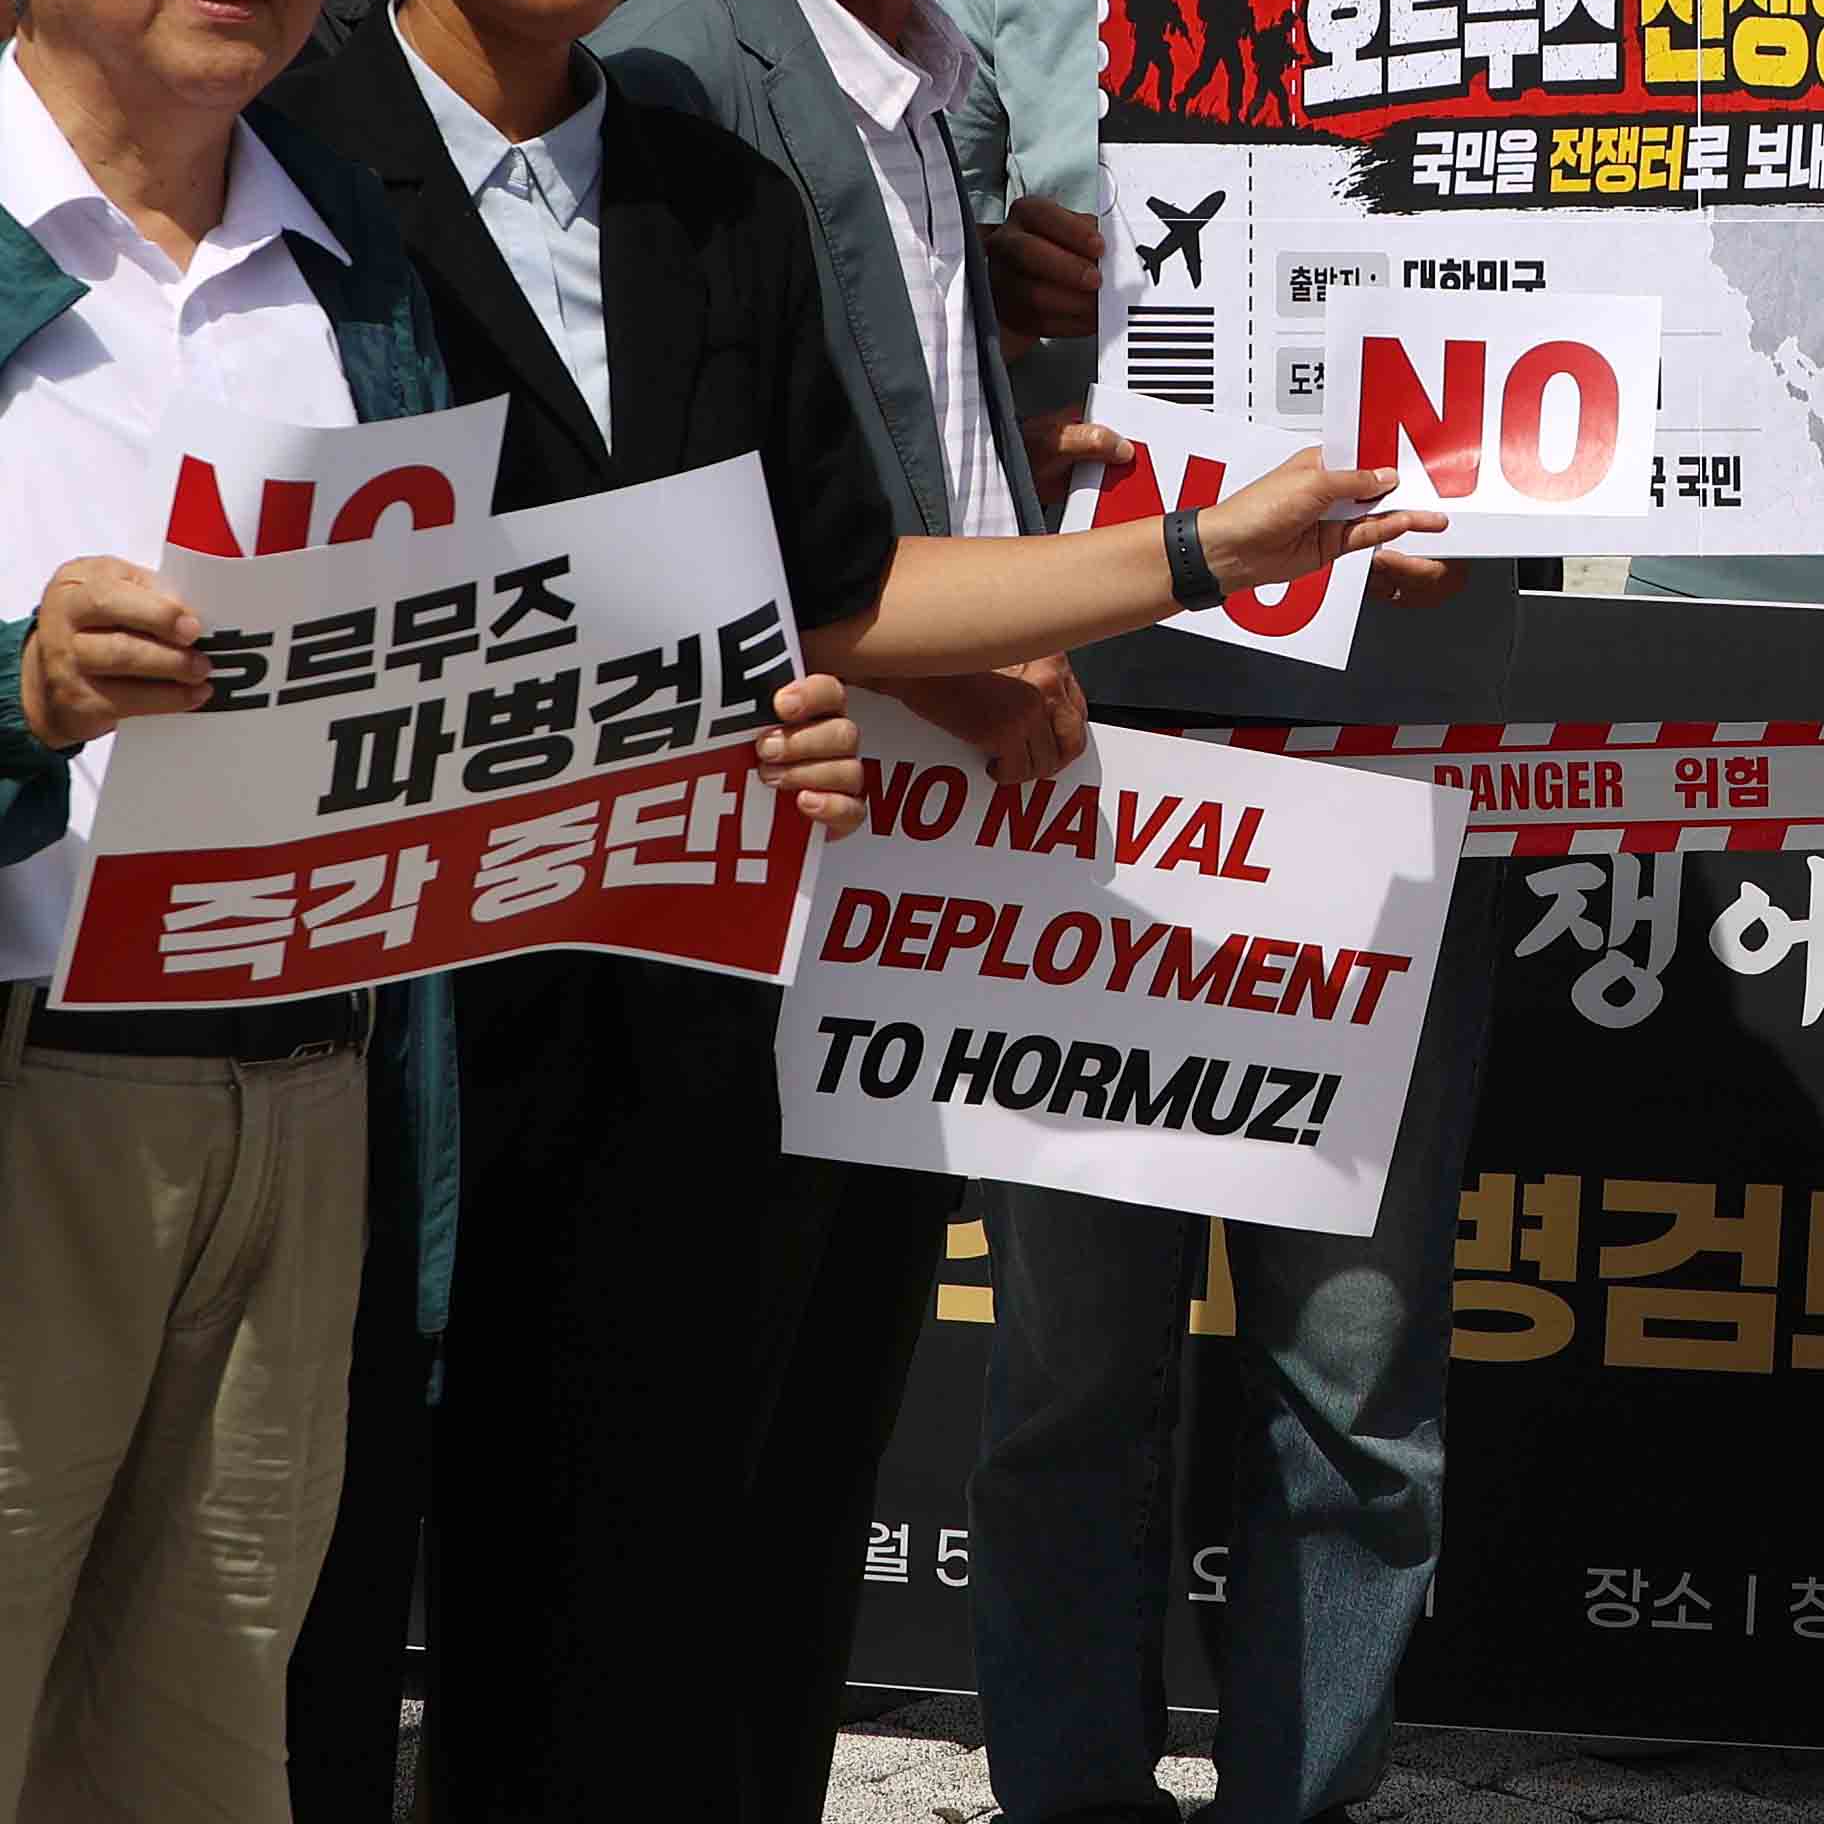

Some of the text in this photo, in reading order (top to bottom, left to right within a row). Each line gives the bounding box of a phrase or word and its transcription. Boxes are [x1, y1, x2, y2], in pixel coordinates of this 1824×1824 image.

[1412, 129, 1538, 195] 국민을
[1549, 123, 1730, 194] 전쟁터로
[1356, 335, 1620, 503] NO
[1676, 455, 1742, 508] 국민
[199, 555, 579, 714] 호르무즈
[316, 599, 797, 817] 파병검토
[860, 757, 1272, 884] NO NAVAL
[1674, 756, 1770, 809] 위험
[157, 768, 778, 983] 즉각 중단!
[819, 887, 1412, 1026] DEPLOYMENT
[815, 1016, 1343, 1147] TO HORMUZ!
[1582, 1567, 1715, 1636] 장소
